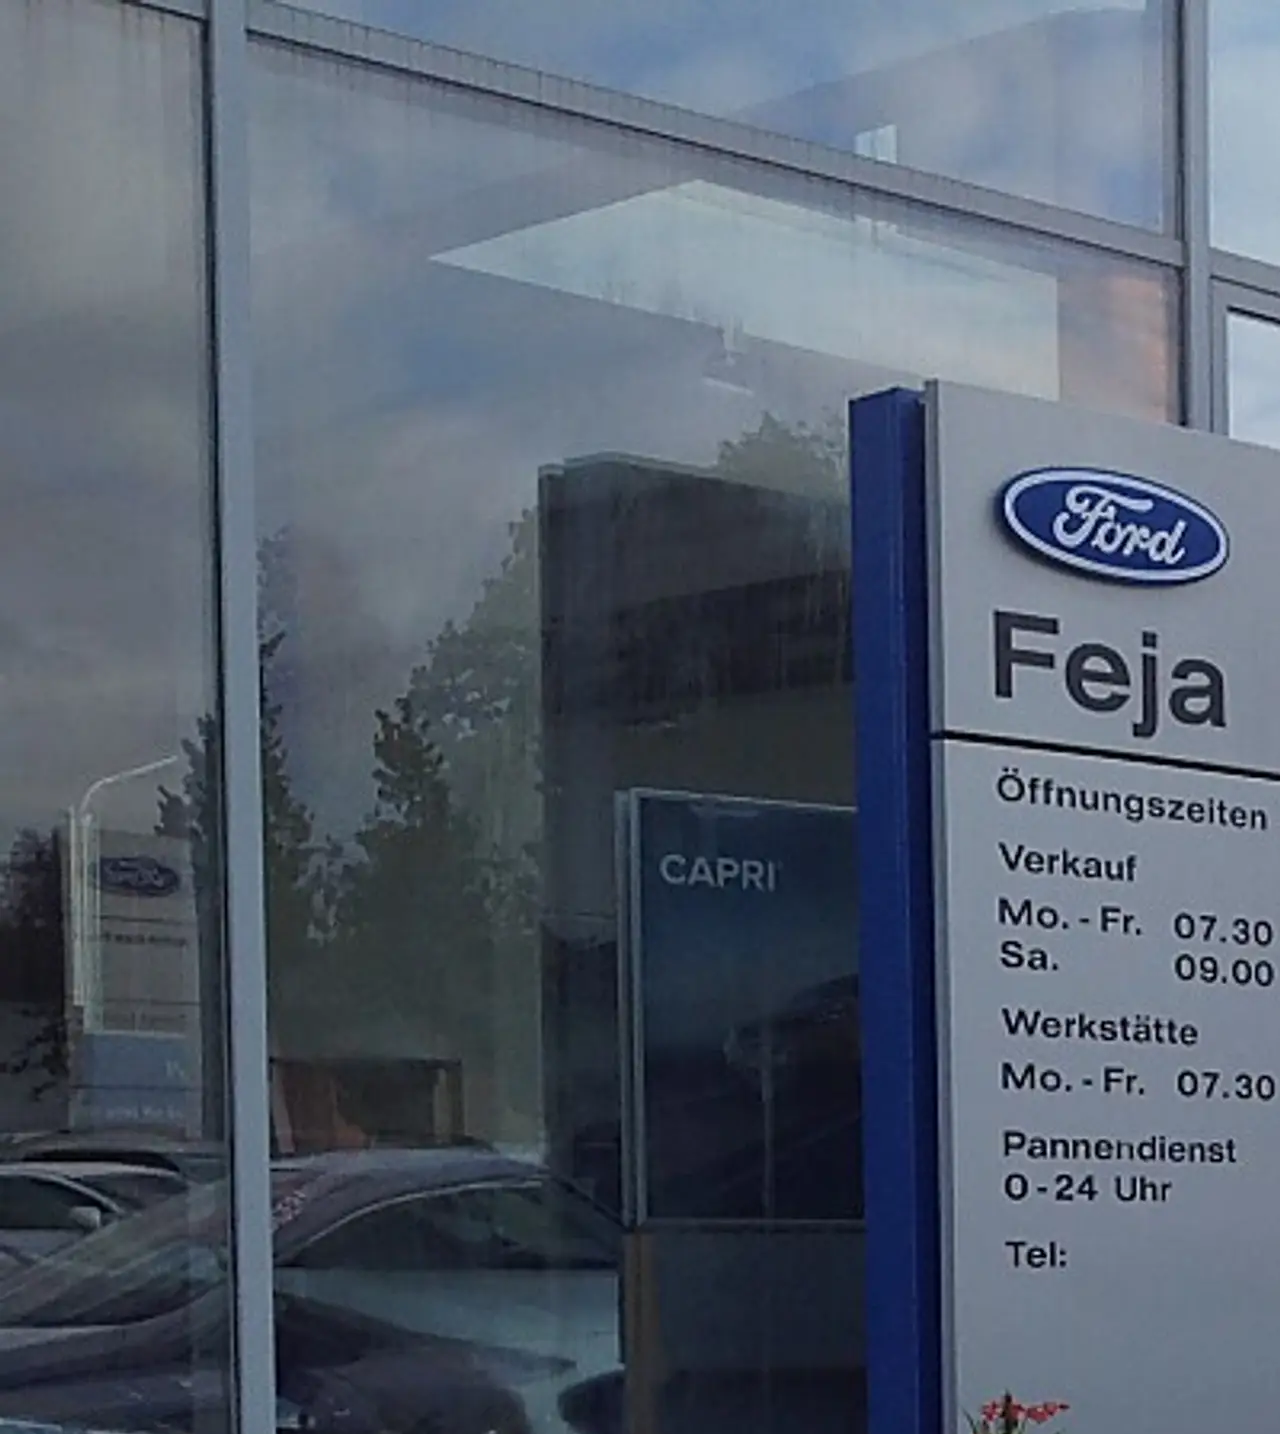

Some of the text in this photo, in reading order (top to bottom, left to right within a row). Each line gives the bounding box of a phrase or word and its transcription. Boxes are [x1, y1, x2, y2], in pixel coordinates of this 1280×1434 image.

[1053, 485, 1187, 564] Ford
[994, 609, 1227, 738] Feja
[997, 767, 1268, 831] Öffnungszeiten
[660, 853, 776, 893] CAPRI
[999, 841, 1138, 882] Verkauf
[998, 897, 1069, 930] Mo.
[1100, 905, 1142, 936] Fr.
[1174, 912, 1273, 947] 07.30
[1000, 940, 1058, 971] Sa.
[1174, 954, 1274, 987] 09.00
[1002, 1007, 1199, 1047] Werkstätte
[1001, 1062, 1072, 1093] Mo.
[1104, 1066, 1145, 1096] Fr.
[1177, 1070, 1276, 1101] 07.30
[1003, 1131, 1237, 1163] Pannendienst
[1114, 1176, 1173, 1202] Uhr
[1005, 1240, 1068, 1268] Tel:
